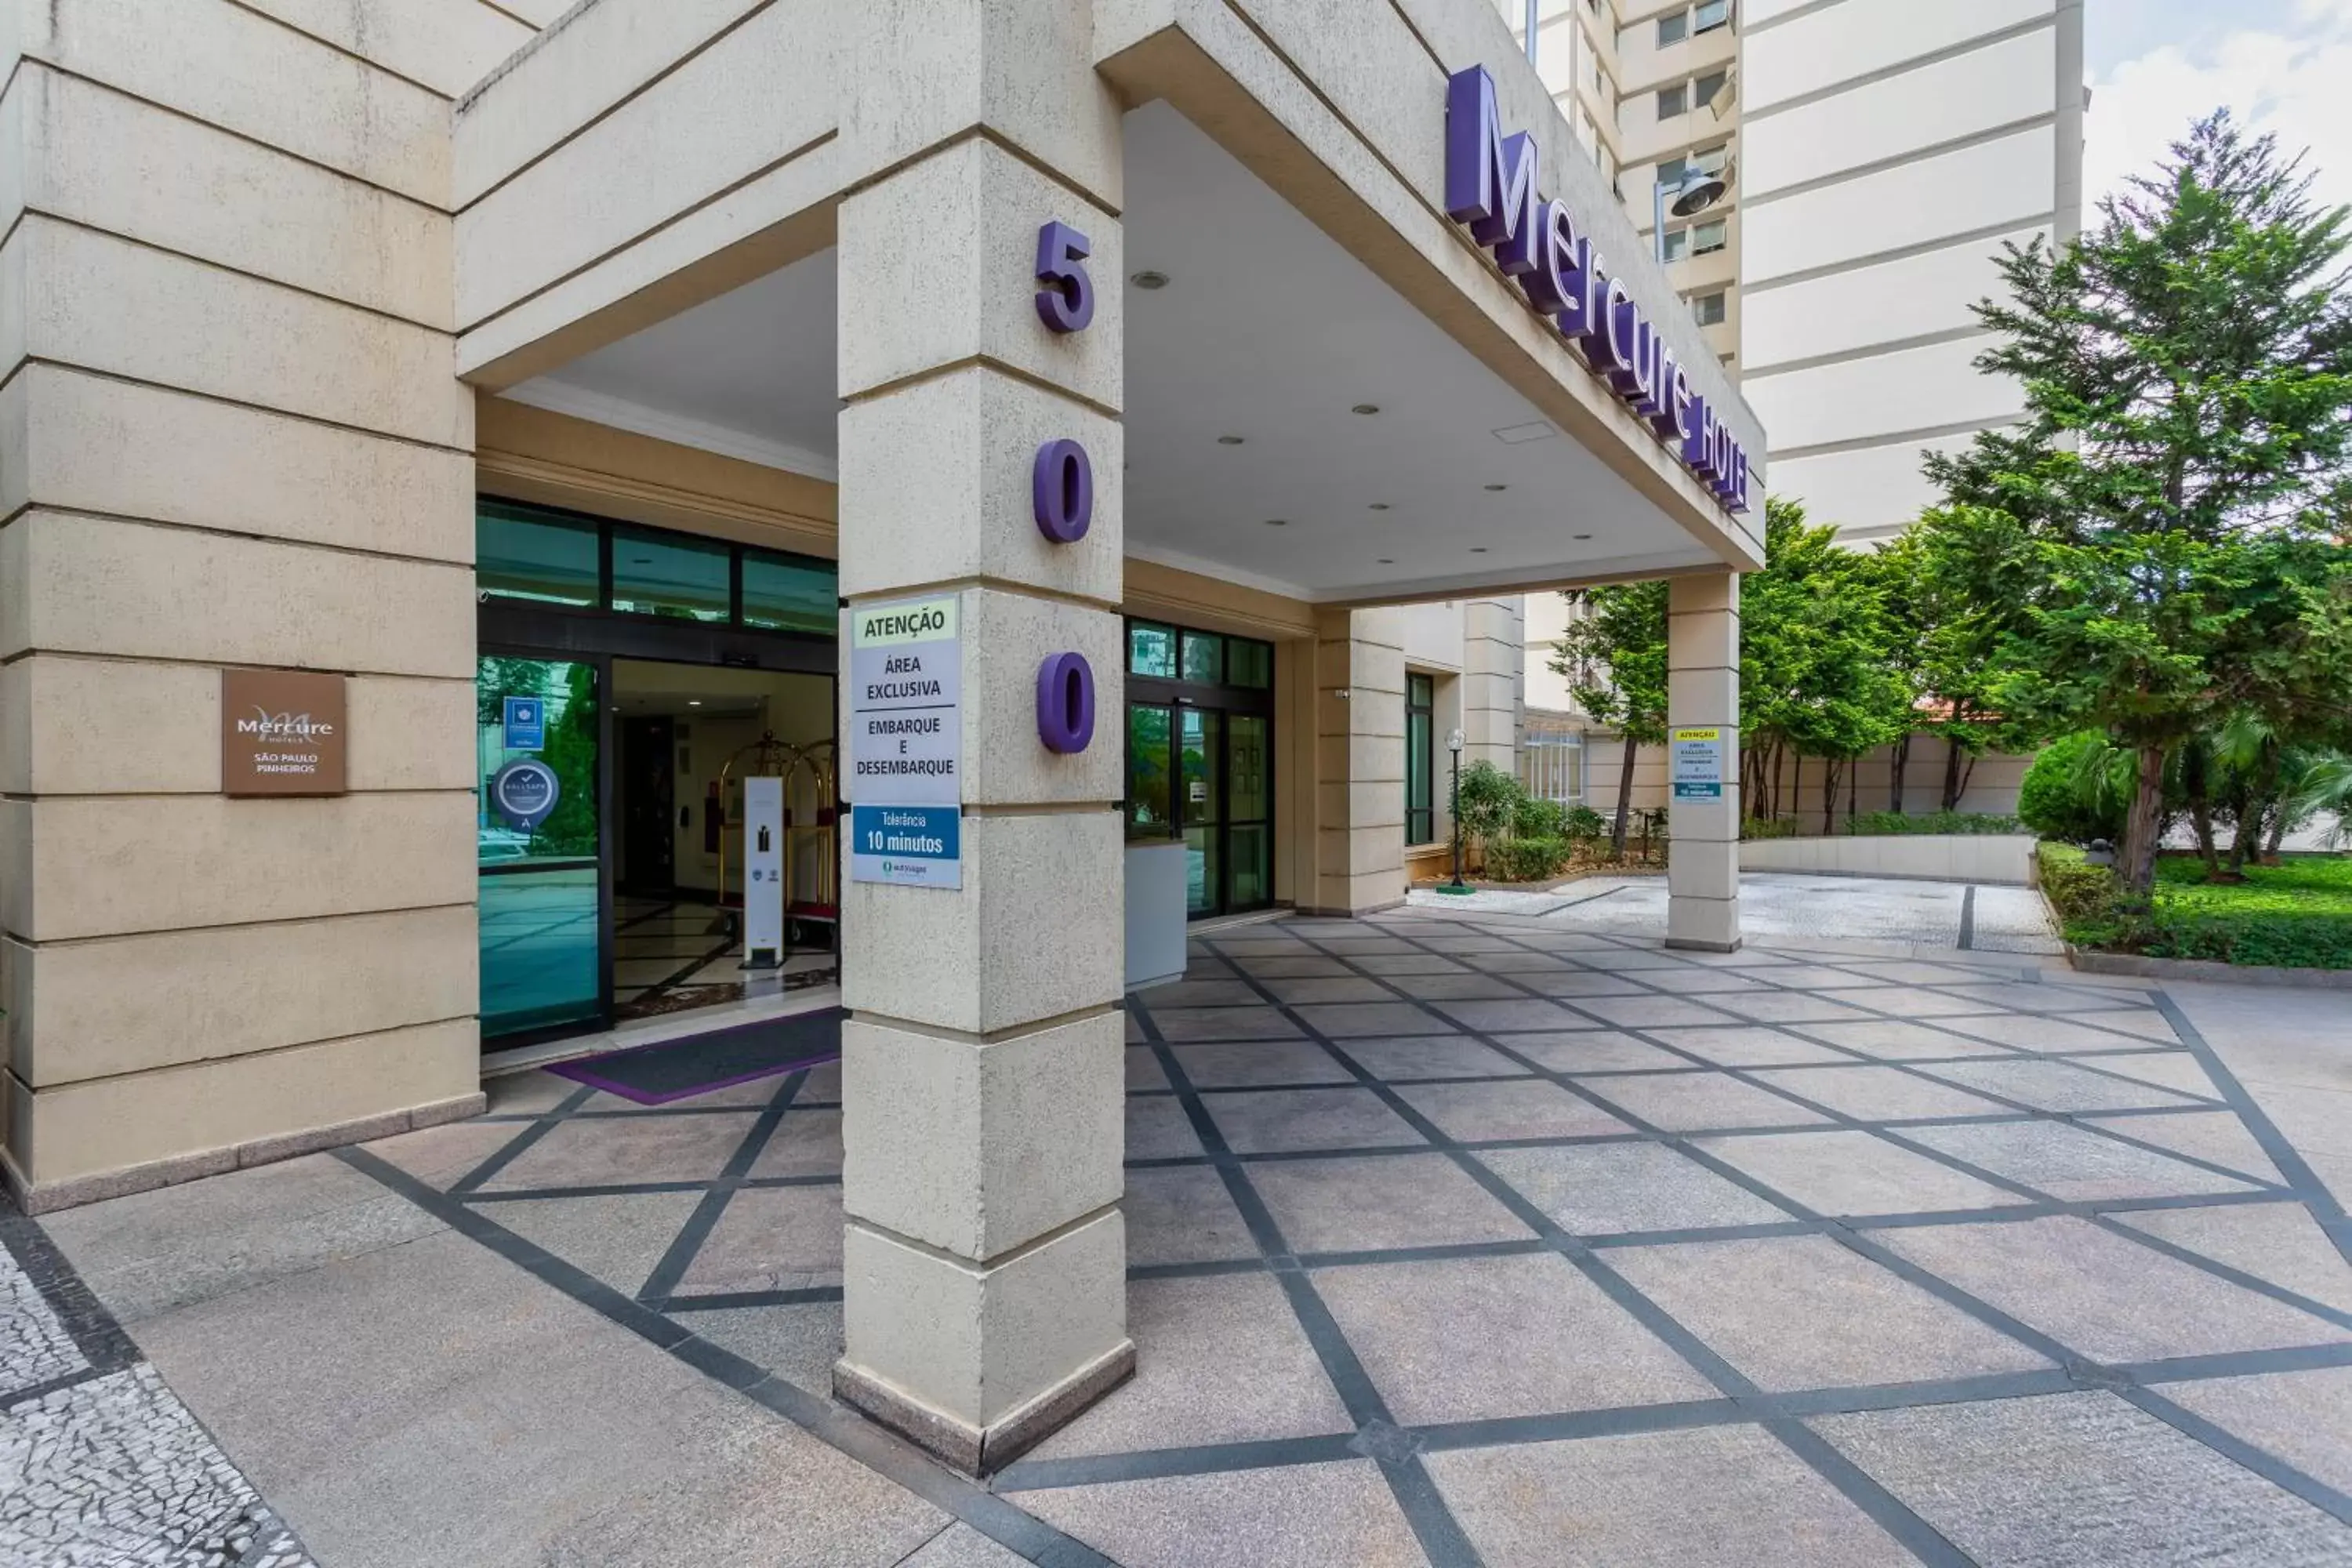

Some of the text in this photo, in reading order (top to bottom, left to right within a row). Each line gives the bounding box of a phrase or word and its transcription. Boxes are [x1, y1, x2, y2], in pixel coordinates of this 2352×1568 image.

[1445, 63, 1751, 514] Mercure HOTEL
[864, 606, 946, 640] ATENÇÃO
[884, 655, 921, 675] ÁREA
[867, 680, 942, 700] EXCLUSIVA
[238, 719, 333, 735] Mercure
[869, 717, 941, 735] EMBARQUE
[899, 740, 907, 753] E
[254, 753, 318, 763] SÃO PAULO
[256, 764, 315, 774] PINHEIROS
[857, 760, 954, 777] DESEMBARQUE
[882, 811, 926, 827] Tolerância
[868, 830, 943, 854] 10 minutos
